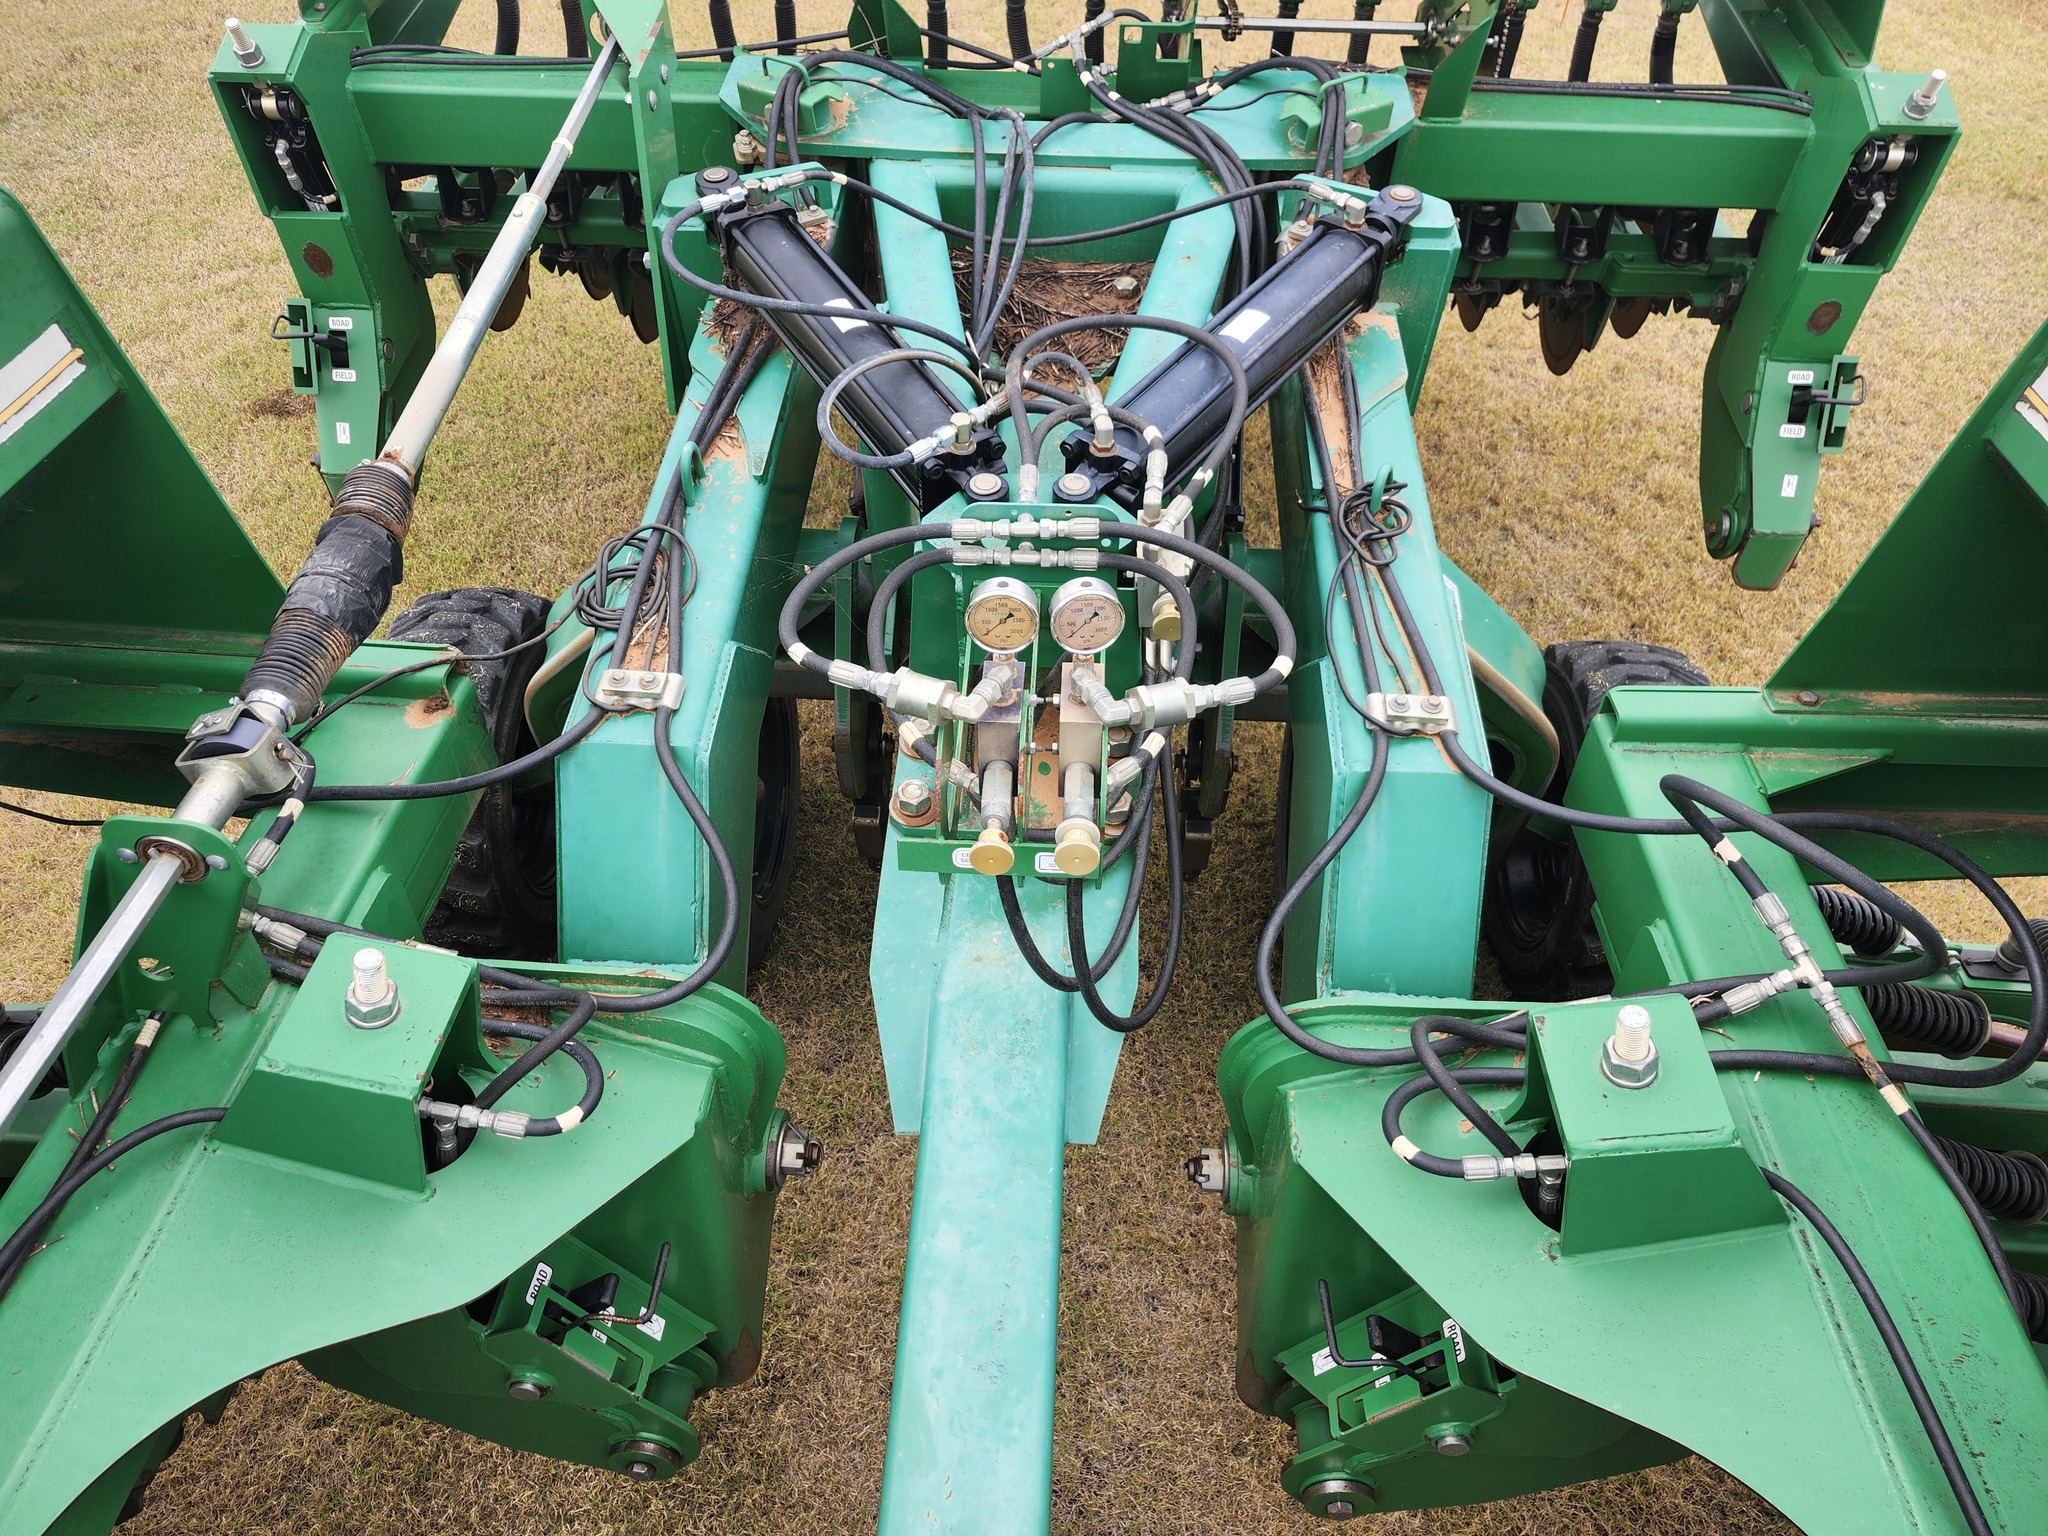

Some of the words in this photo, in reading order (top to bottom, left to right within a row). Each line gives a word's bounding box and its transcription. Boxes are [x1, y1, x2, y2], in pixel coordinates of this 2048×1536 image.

[332, 319, 350, 327] ROAD
[335, 371, 353, 380] FIELD
[1791, 373, 1811, 381] ROAD
[1783, 427, 1802, 435] FIELD
